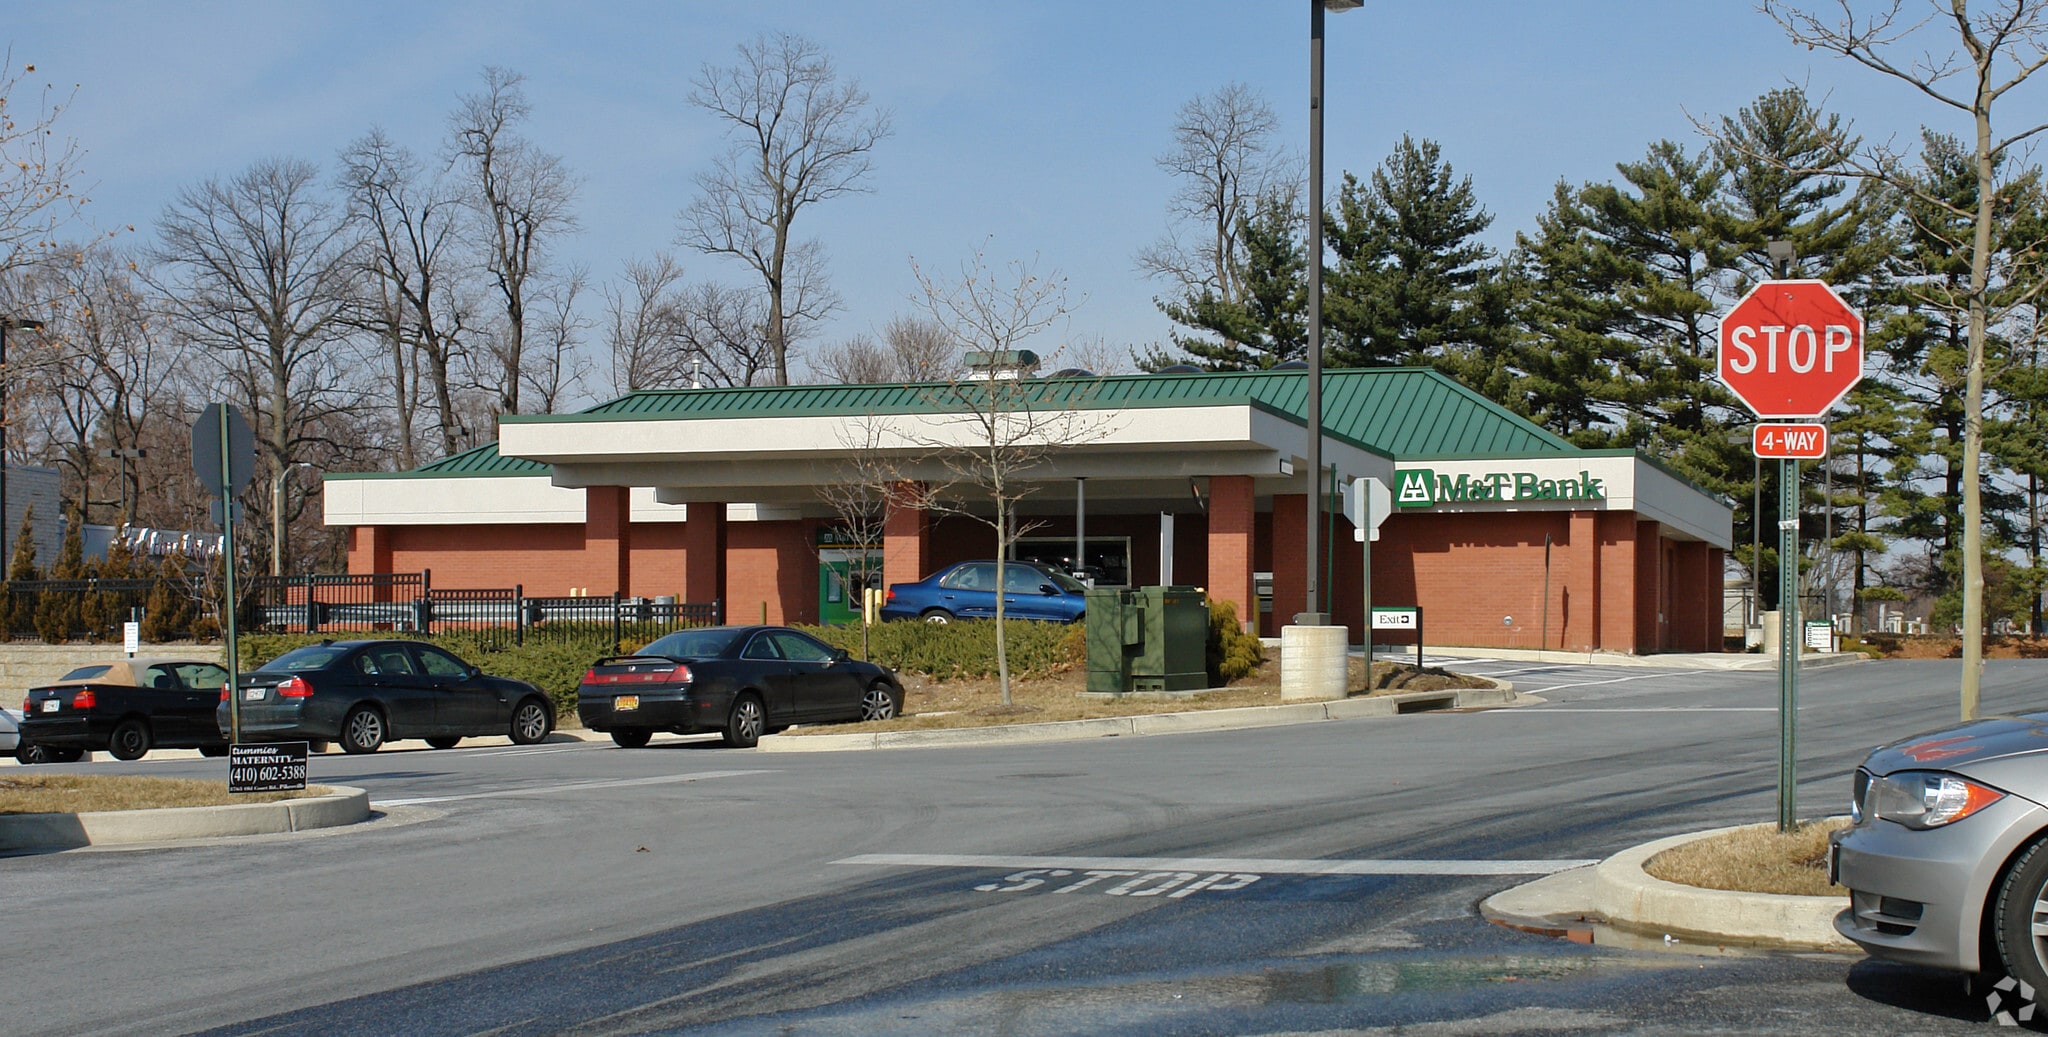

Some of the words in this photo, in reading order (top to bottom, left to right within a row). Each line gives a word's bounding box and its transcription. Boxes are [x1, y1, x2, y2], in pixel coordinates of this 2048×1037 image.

[1729, 324, 1853, 374] STOP
[1761, 431, 1818, 451] 4-WAY
[1437, 473, 1511, 501] M&T
[1512, 471, 1604, 500] Bank
[1379, 615, 1400, 624] Exit
[230, 767, 258, 785] (410)
[260, 765, 306, 781] 602-5388
[974, 869, 1261, 898] STOP
